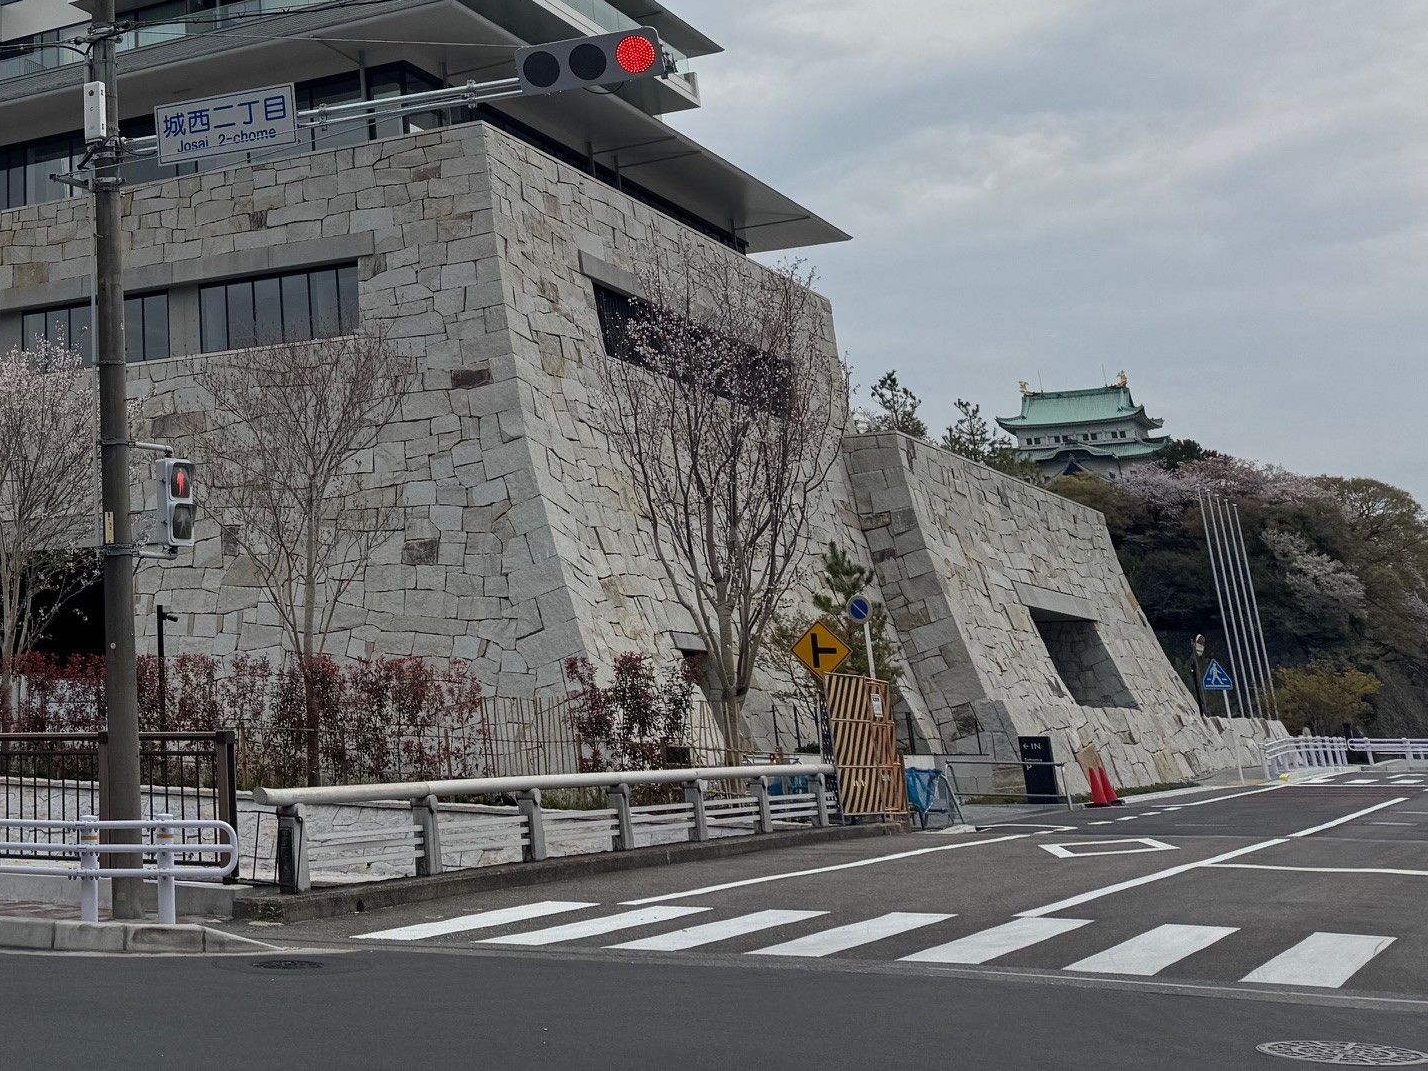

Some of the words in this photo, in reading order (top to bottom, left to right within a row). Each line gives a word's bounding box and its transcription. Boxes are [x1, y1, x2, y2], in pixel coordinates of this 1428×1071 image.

[163, 95, 286, 138] 城西二丁目
[177, 136, 209, 153] Josai
[218, 128, 277, 145] 2-chome
[1030, 742, 1042, 750] IN
